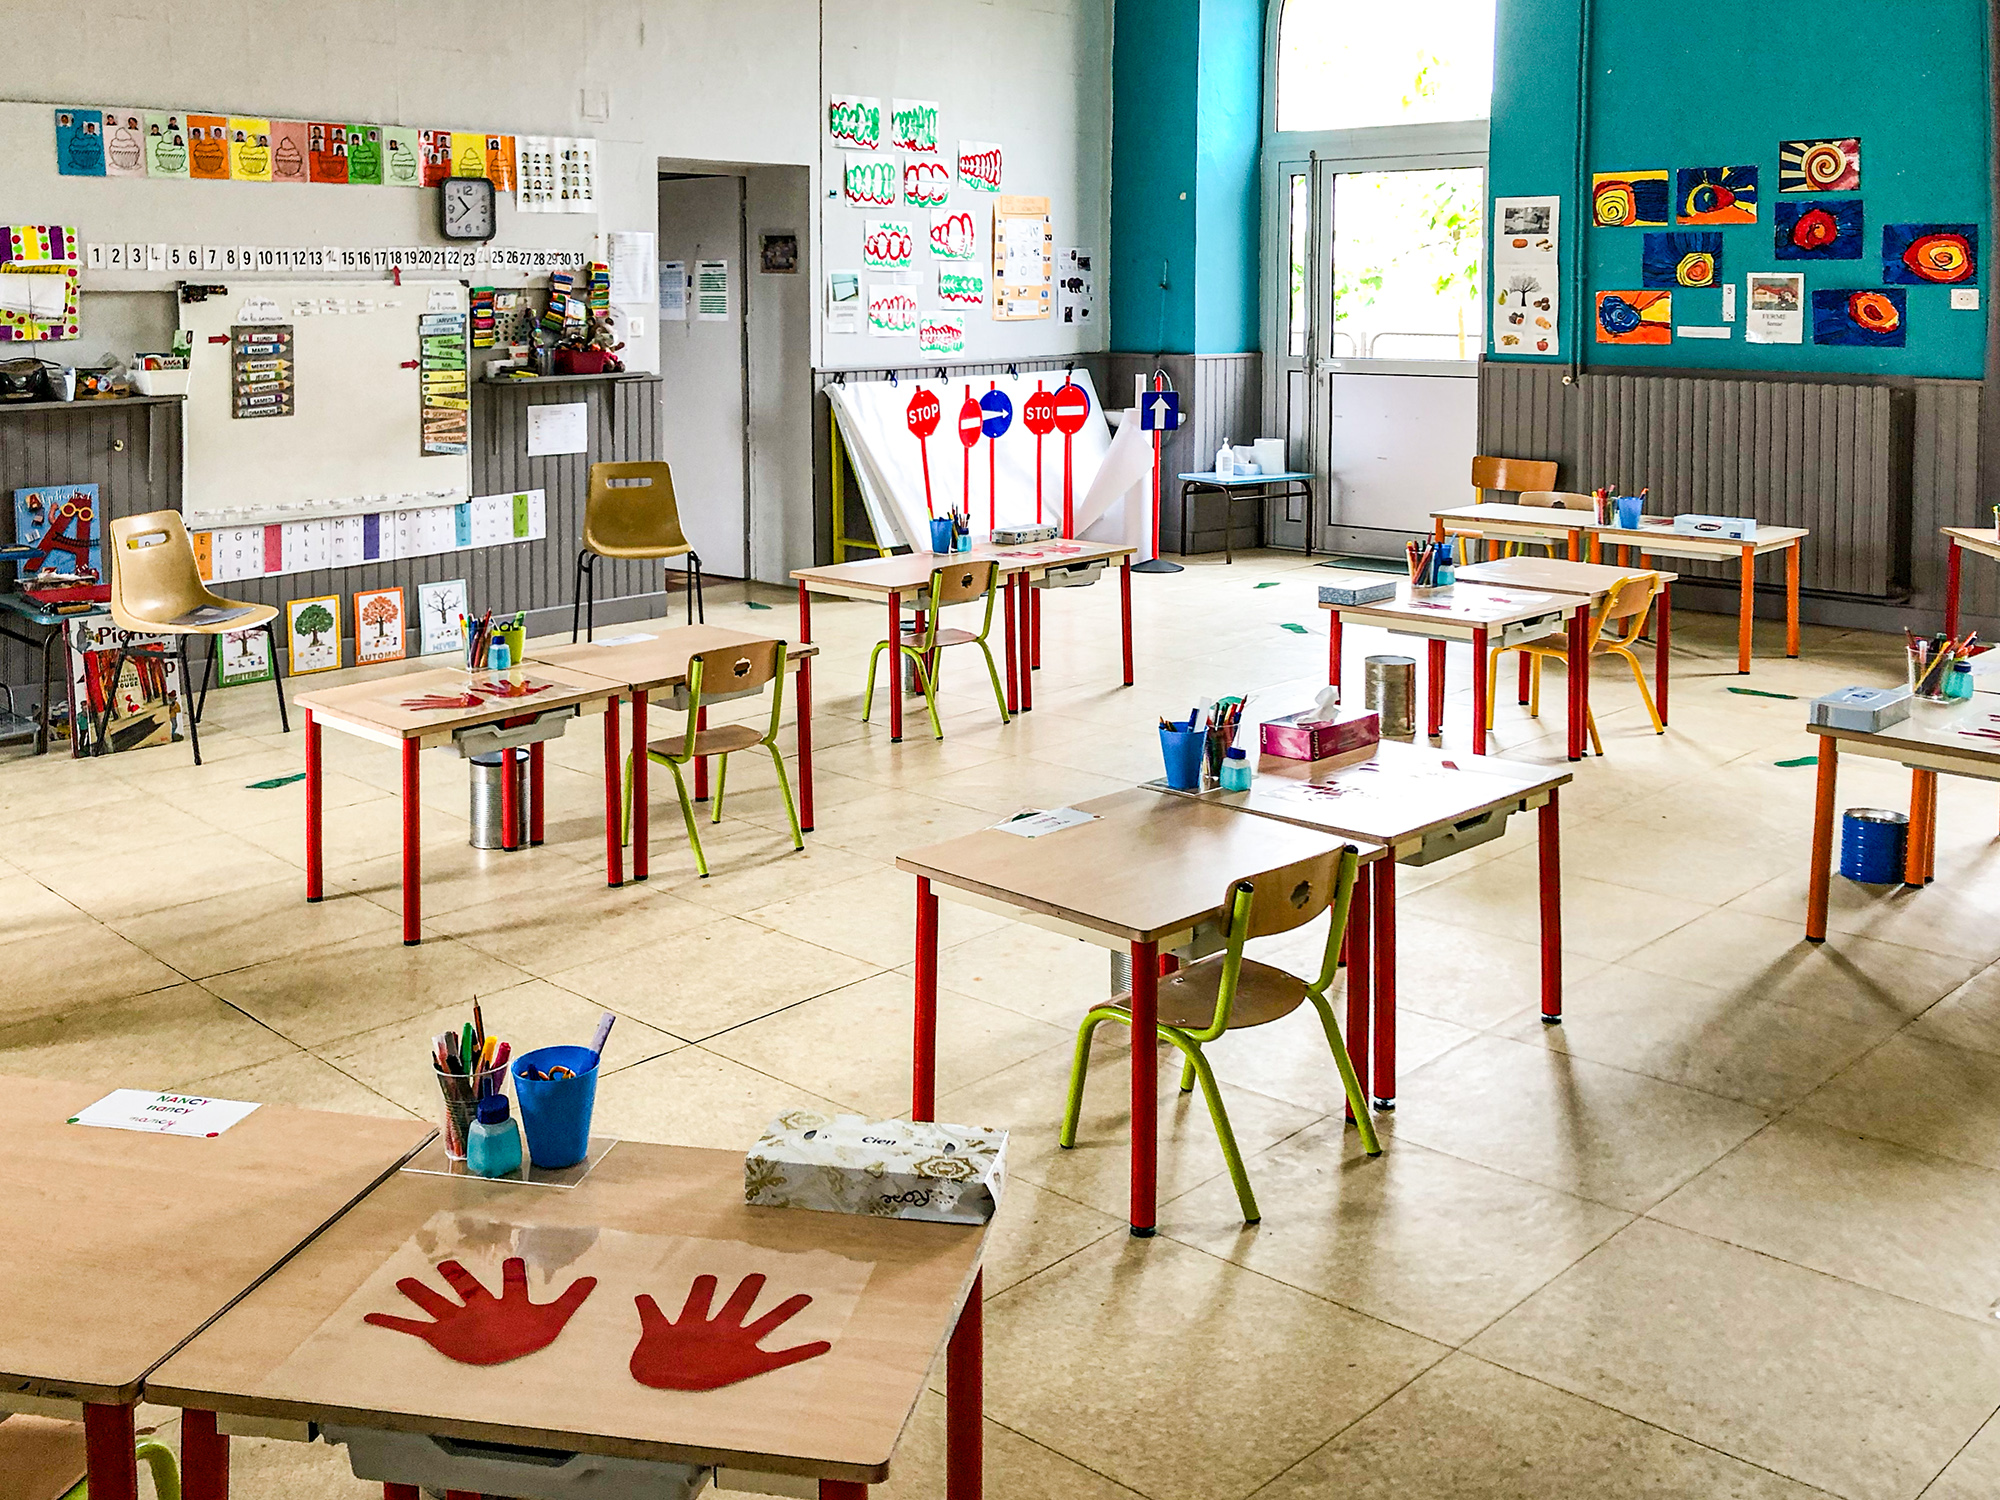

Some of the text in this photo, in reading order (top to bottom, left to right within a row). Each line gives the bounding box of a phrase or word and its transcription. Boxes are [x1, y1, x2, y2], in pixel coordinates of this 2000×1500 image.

[463, 186, 473, 196] 12
[448, 205, 455, 214] 9
[465, 224, 472, 233] 6
[93, 247, 100, 263] 1
[111, 248, 120, 263] 2
[132, 247, 141, 263] 3
[172, 249, 180, 264] 5
[188, 249, 197, 265] 6
[208, 249, 216, 264] 7
[226, 250, 235, 264] 8
[243, 250, 251, 265] 9
[258, 251, 273, 265] 10
[275, 251, 289, 265] 11
[292, 250, 306, 265] 12
[308, 251, 323, 265] 13
[341, 251, 355, 266] 15
[357, 251, 371, 265] 16
[374, 251, 387, 266] 17
[389, 250, 402, 264] 18
[404, 250, 417, 265] 19
[418, 250, 432, 264] 20
[433, 251, 446, 265] 21
[448, 250, 461, 264] 22
[462, 252, 476, 266] 23
[492, 250, 504, 264] 25
[506, 250, 518, 264] 26
[519, 252, 532, 266] 27
[533, 252, 546, 266] 28
[546, 252, 559, 266] 29
[559, 252, 571, 266] 30
[573, 252, 585, 266] 31
[253, 384, 278, 392] VENDREDI
[908, 403, 939, 424] STOP
[1026, 406, 1053, 421] STO
[199, 536, 206, 545] E
[218, 533, 223, 542] F
[235, 532, 242, 542] G
[252, 530, 259, 539] H
[287, 527, 292, 535] J
[304, 524, 310, 533] K
[320, 522, 325, 531] L
[335, 520, 344, 529] M
[352, 518, 359, 527] N
[385, 515, 390, 524] P
[399, 512, 407, 521] Q
[416, 510, 421, 518] R
[431, 509, 436, 517] S
[488, 502, 496, 510] W
[503, 500, 509, 508] X
[516, 495, 523, 505] Y
[358, 649, 403, 662] AUTOMNE
[156, 1095, 212, 1106] NANCY
[146, 1104, 194, 1115] nancy
[129, 1116, 177, 1131] nancy
[861, 1135, 897, 1146] Cien
[880, 1189, 930, 1208] Rose
